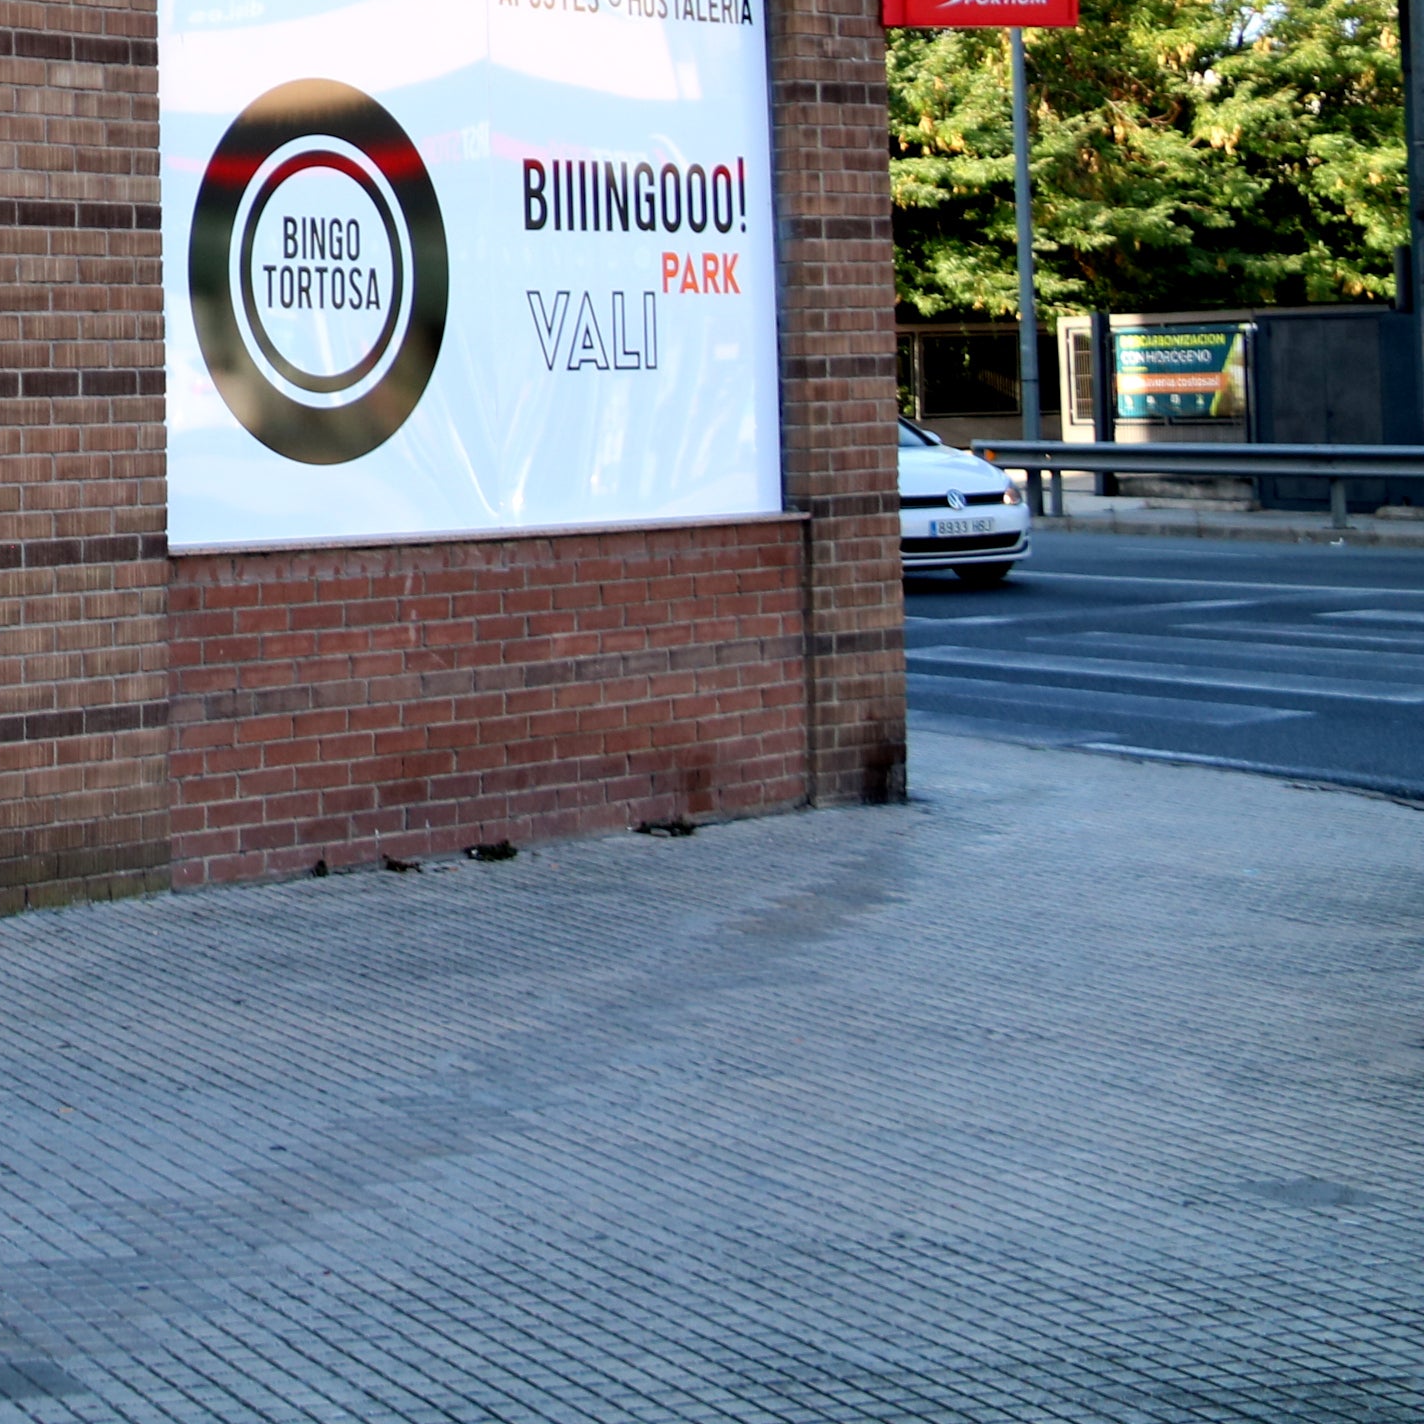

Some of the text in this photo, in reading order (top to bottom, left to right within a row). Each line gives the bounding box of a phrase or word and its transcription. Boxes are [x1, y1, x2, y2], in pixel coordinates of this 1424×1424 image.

[523, 156, 747, 234] BIIIINGOOO!
[282, 215, 361, 262] BINGO
[262, 264, 382, 311] TORTOSA
[662, 251, 742, 295] PARK
[525, 289, 659, 372] VALI
[938, 520, 968, 534] 8933
